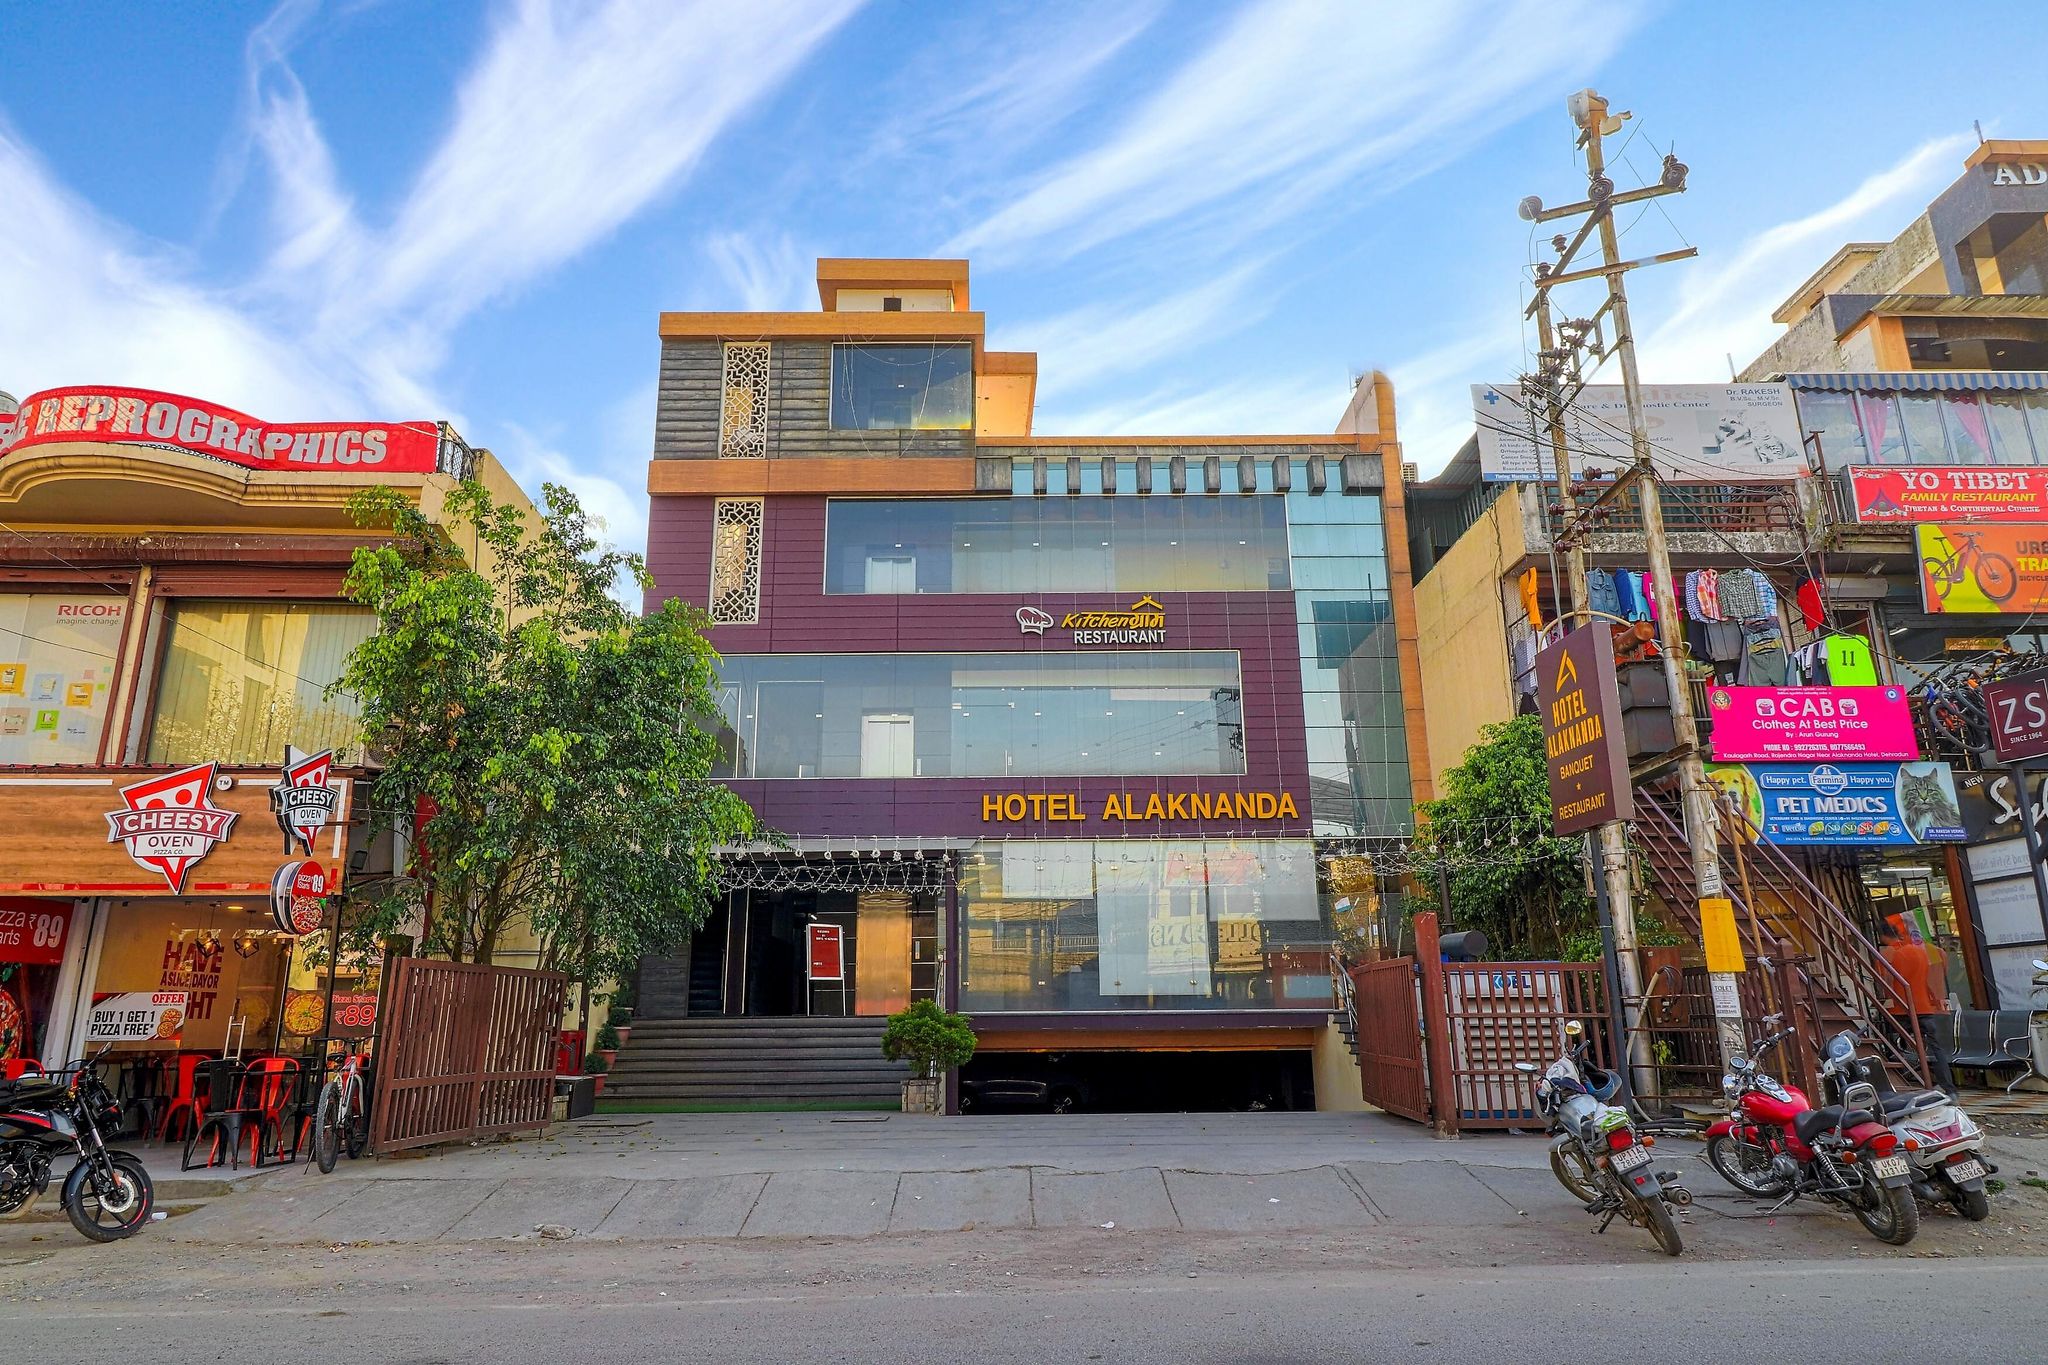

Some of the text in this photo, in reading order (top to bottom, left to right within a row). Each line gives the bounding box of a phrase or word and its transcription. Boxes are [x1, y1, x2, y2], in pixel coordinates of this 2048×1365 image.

[34, 395, 388, 465] REPROGRAPHICS
[1900, 472, 2031, 490] YO TIBET
[1901, 493, 2038, 501] FAMILY RESTAURANT
[57, 605, 122, 616] RICOH
[1074, 630, 1167, 644] RESTAURANT
[1841, 650, 1856, 667] 11
[1552, 688, 1588, 728] HOTEL
[1780, 698, 1835, 717] CAB
[1752, 719, 1868, 729] Clothes At Best Price
[1547, 714, 1603, 760] ALAKNANDA
[2009, 731, 2043, 744] SINCE 1964
[1560, 754, 1594, 780] BANQUET
[1766, 775, 1893, 785] Happy pet. Farmina Happy you.
[1964, 774, 1985, 789] NEW
[289, 790, 335, 806] CHEESY
[1776, 796, 1888, 813] PET MEDICS
[981, 792, 1299, 821] HOTEL ALAKNANDA
[1559, 792, 1606, 820] RESTAURANT
[300, 809, 321, 819] OVEN
[123, 812, 223, 832] CHEESY
[148, 835, 194, 847] OVEN
[151, 993, 185, 1004] OFFER
[94, 1011, 156, 1022] BUY 1 GET 1
[90, 1024, 120, 1035] PIZZA
[1880, 1158, 1901, 1168] UK07
[1954, 1161, 1974, 1173] UK07
